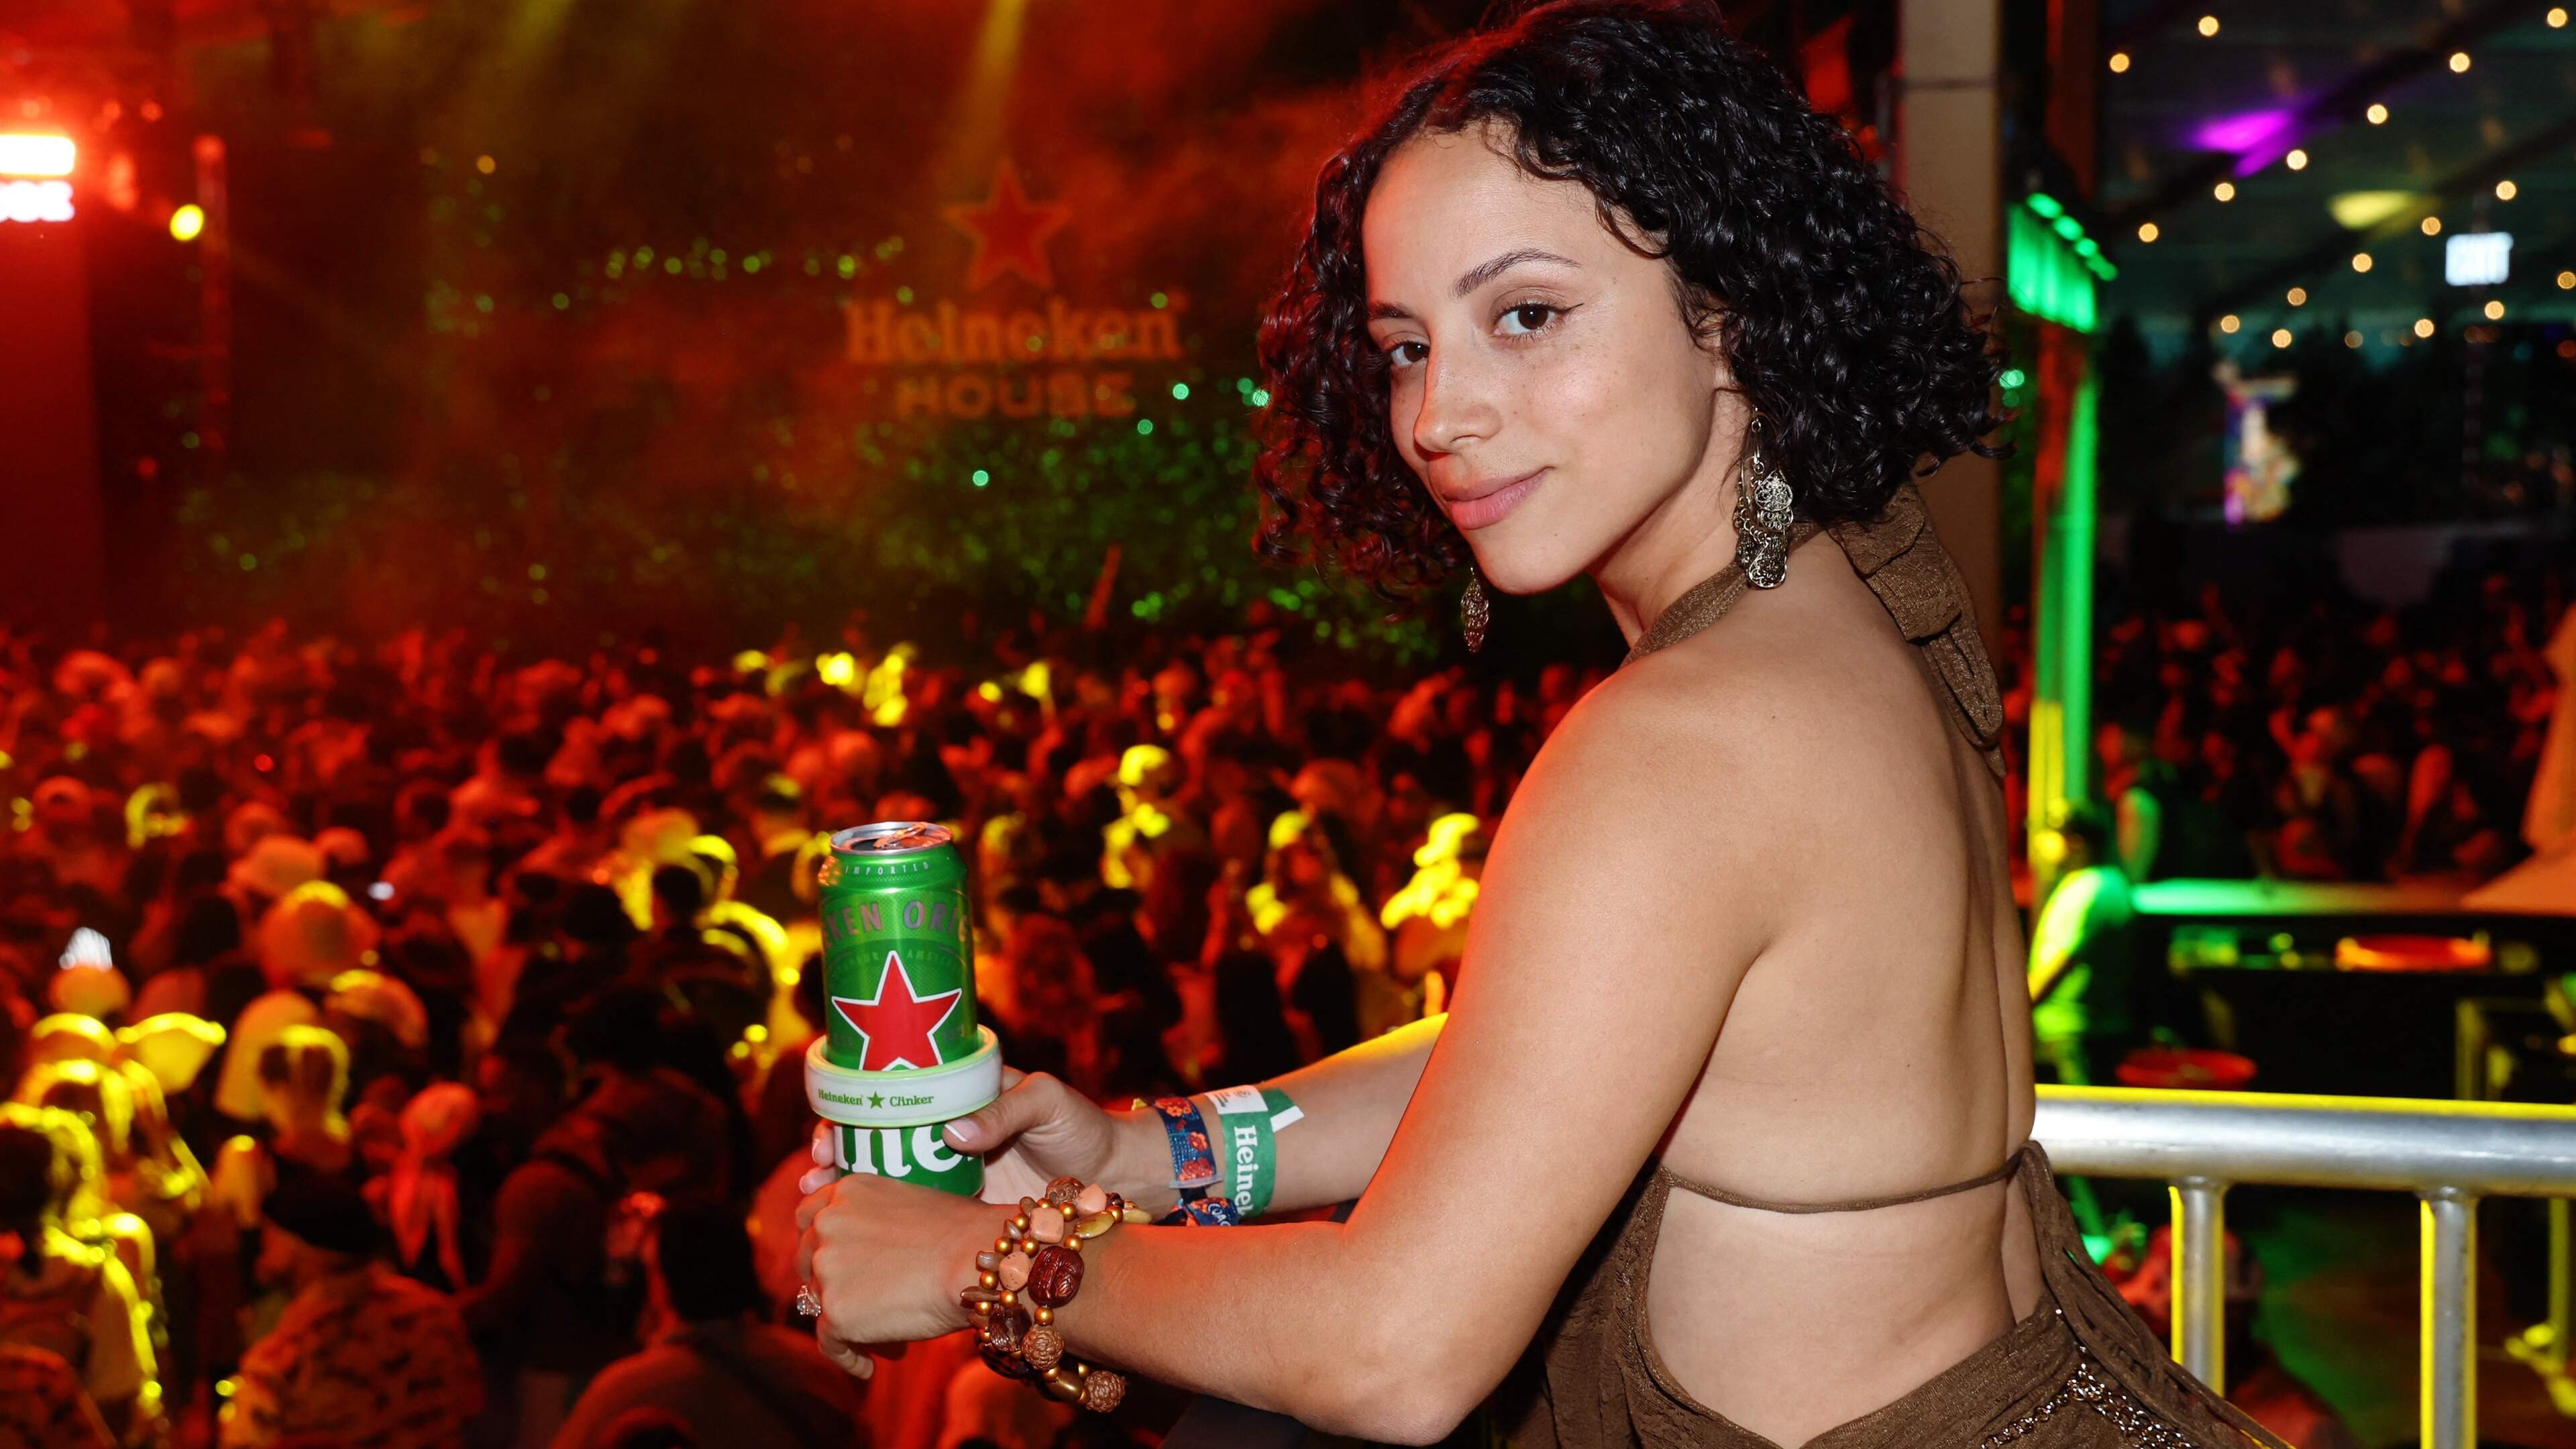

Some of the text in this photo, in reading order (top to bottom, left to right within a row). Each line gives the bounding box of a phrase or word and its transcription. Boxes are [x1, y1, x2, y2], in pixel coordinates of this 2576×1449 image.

[845, 297, 1182, 363] Heineken
[896, 372, 1135, 419] HOUSE
[845, 861, 928, 875] IMPORTED
[824, 902, 883, 948] KEN
[818, 1088, 934, 1107] Heineken Clinker
